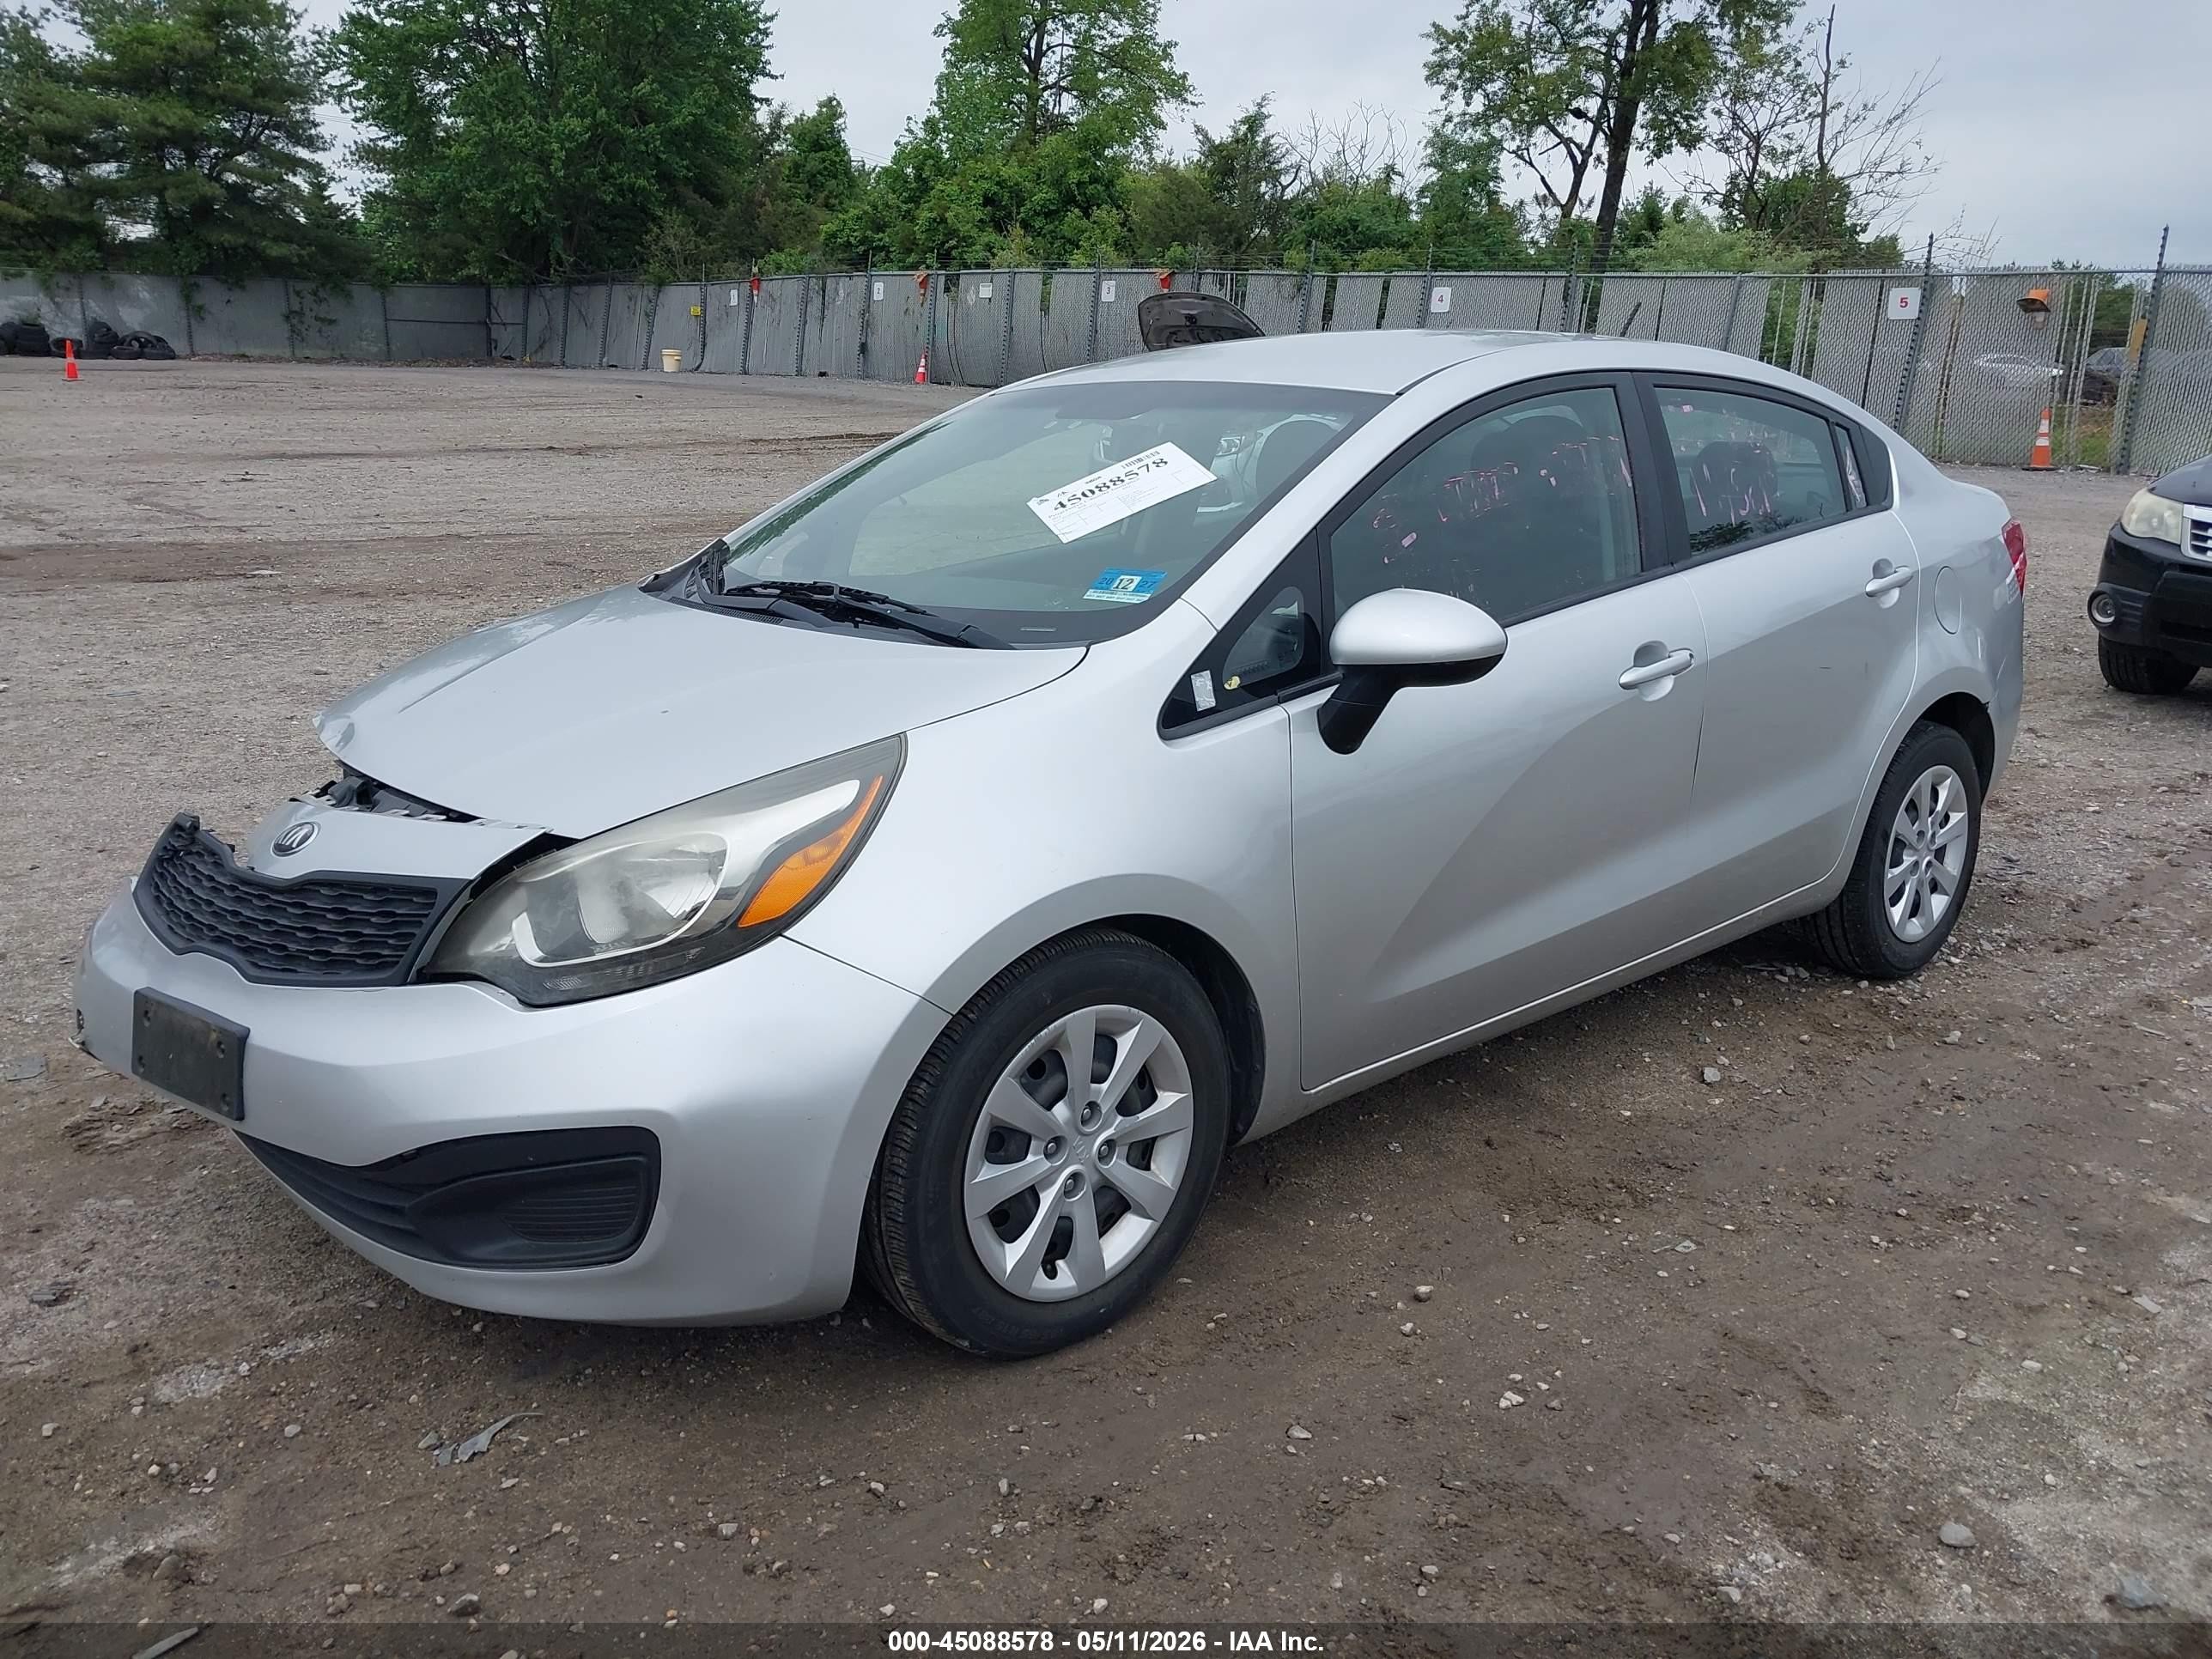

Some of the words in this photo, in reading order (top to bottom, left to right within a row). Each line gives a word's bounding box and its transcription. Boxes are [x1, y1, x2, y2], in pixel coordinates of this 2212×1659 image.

[1437, 295, 1444, 303] 4
[1899, 297, 1909, 308] 5
[1054, 458, 1169, 512] 45088578
[1098, 577, 1115, 586] 20
[1112, 577, 1135, 590] 12
